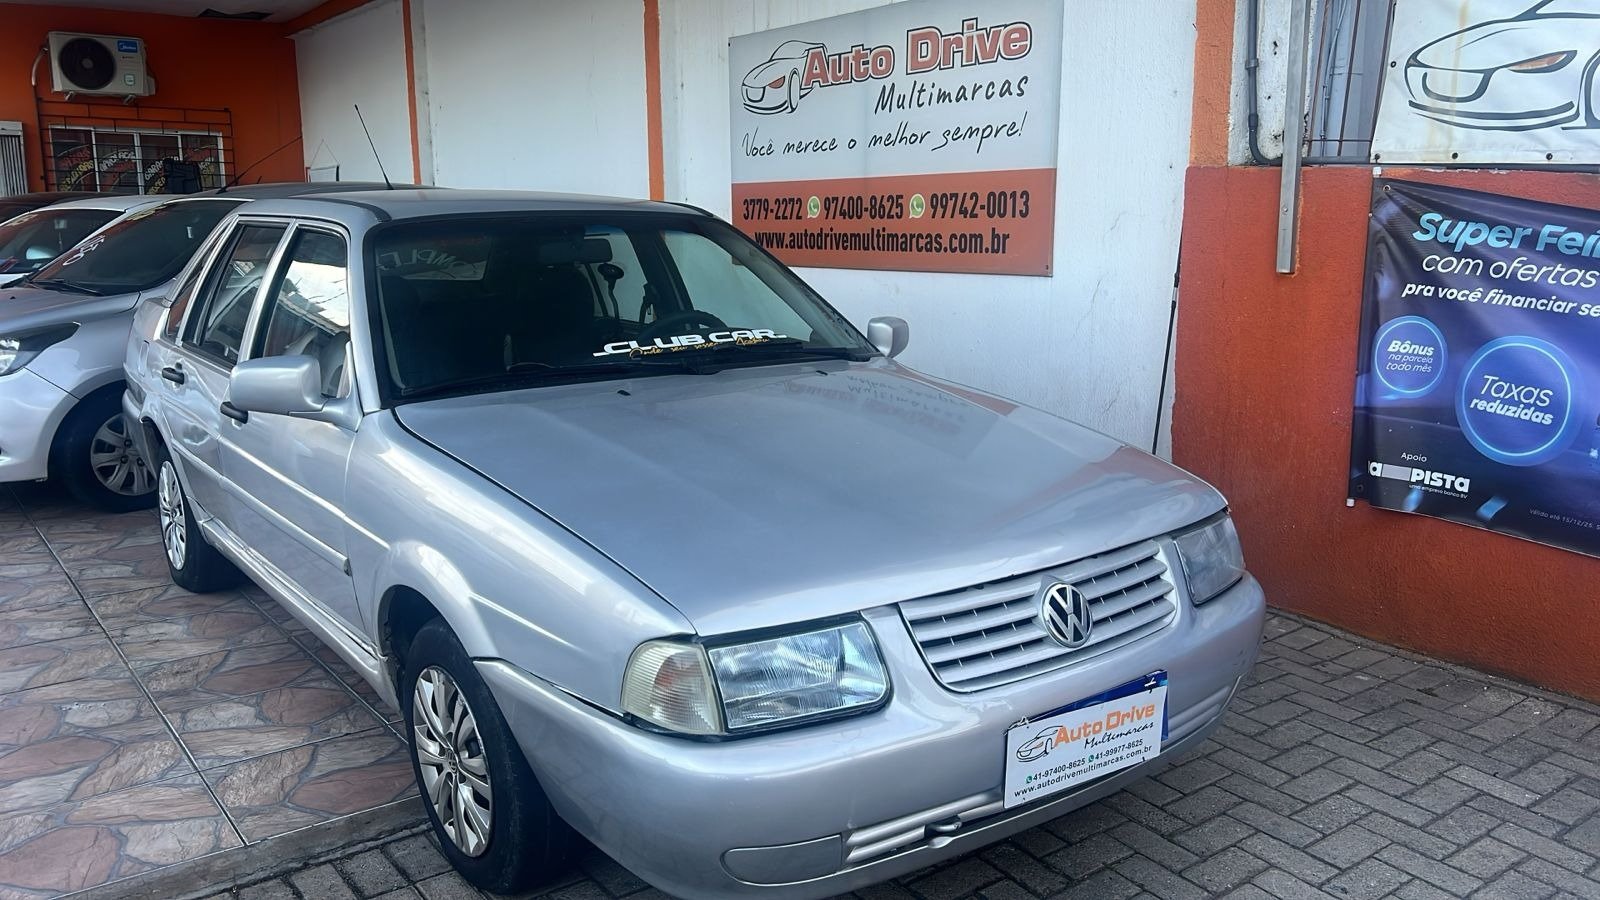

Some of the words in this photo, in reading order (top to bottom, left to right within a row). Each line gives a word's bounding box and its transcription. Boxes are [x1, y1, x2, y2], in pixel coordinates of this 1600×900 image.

[800, 44, 894, 89] Auto
[906, 18, 1032, 75] Drive
[875, 75, 1029, 114] Multimarcas
[742, 127, 774, 157] Você
[783, 138, 838, 155] merece
[847, 138, 857, 149] o
[868, 121, 931, 147] melhor
[931, 111, 1027, 153] sempre!
[743, 198, 803, 220] 3779-2272
[823, 195, 903, 220] 97400-8625
[930, 191, 1030, 219] 99742-0013
[754, 228, 1010, 254] www.autodrivemultimarcas.com.br
[1412, 212, 1532, 253] Super
[1422, 255, 1484, 276] com
[1489, 257, 1599, 289] ofertas
[1401, 282, 1435, 298] pra
[1438, 286, 1484, 302] você
[1483, 289, 1578, 315] financiar
[593, 334, 706, 357] CLUB
[708, 329, 787, 343] CAR
[1387, 340, 1435, 356] Bônus
[1388, 353, 1402, 361] na
[1402, 355, 1433, 364] parcela
[1386, 362, 1411, 371] todo
[1413, 364, 1432, 373] mês
[1480, 374, 1554, 407] Taxas
[1470, 397, 1554, 426] reduzidas
[1400, 452, 1427, 463] Apoio
[1053, 719, 1103, 748] Auto
[1106, 703, 1155, 732] Drive
[1084, 721, 1154, 750] Multimarcas
[1014, 745, 1152, 797] www.autodrivemultimarcas.com.br
[1033, 757, 1086, 781] 41-97400-8625
[1095, 738, 1144, 761] 41-99977-8625
